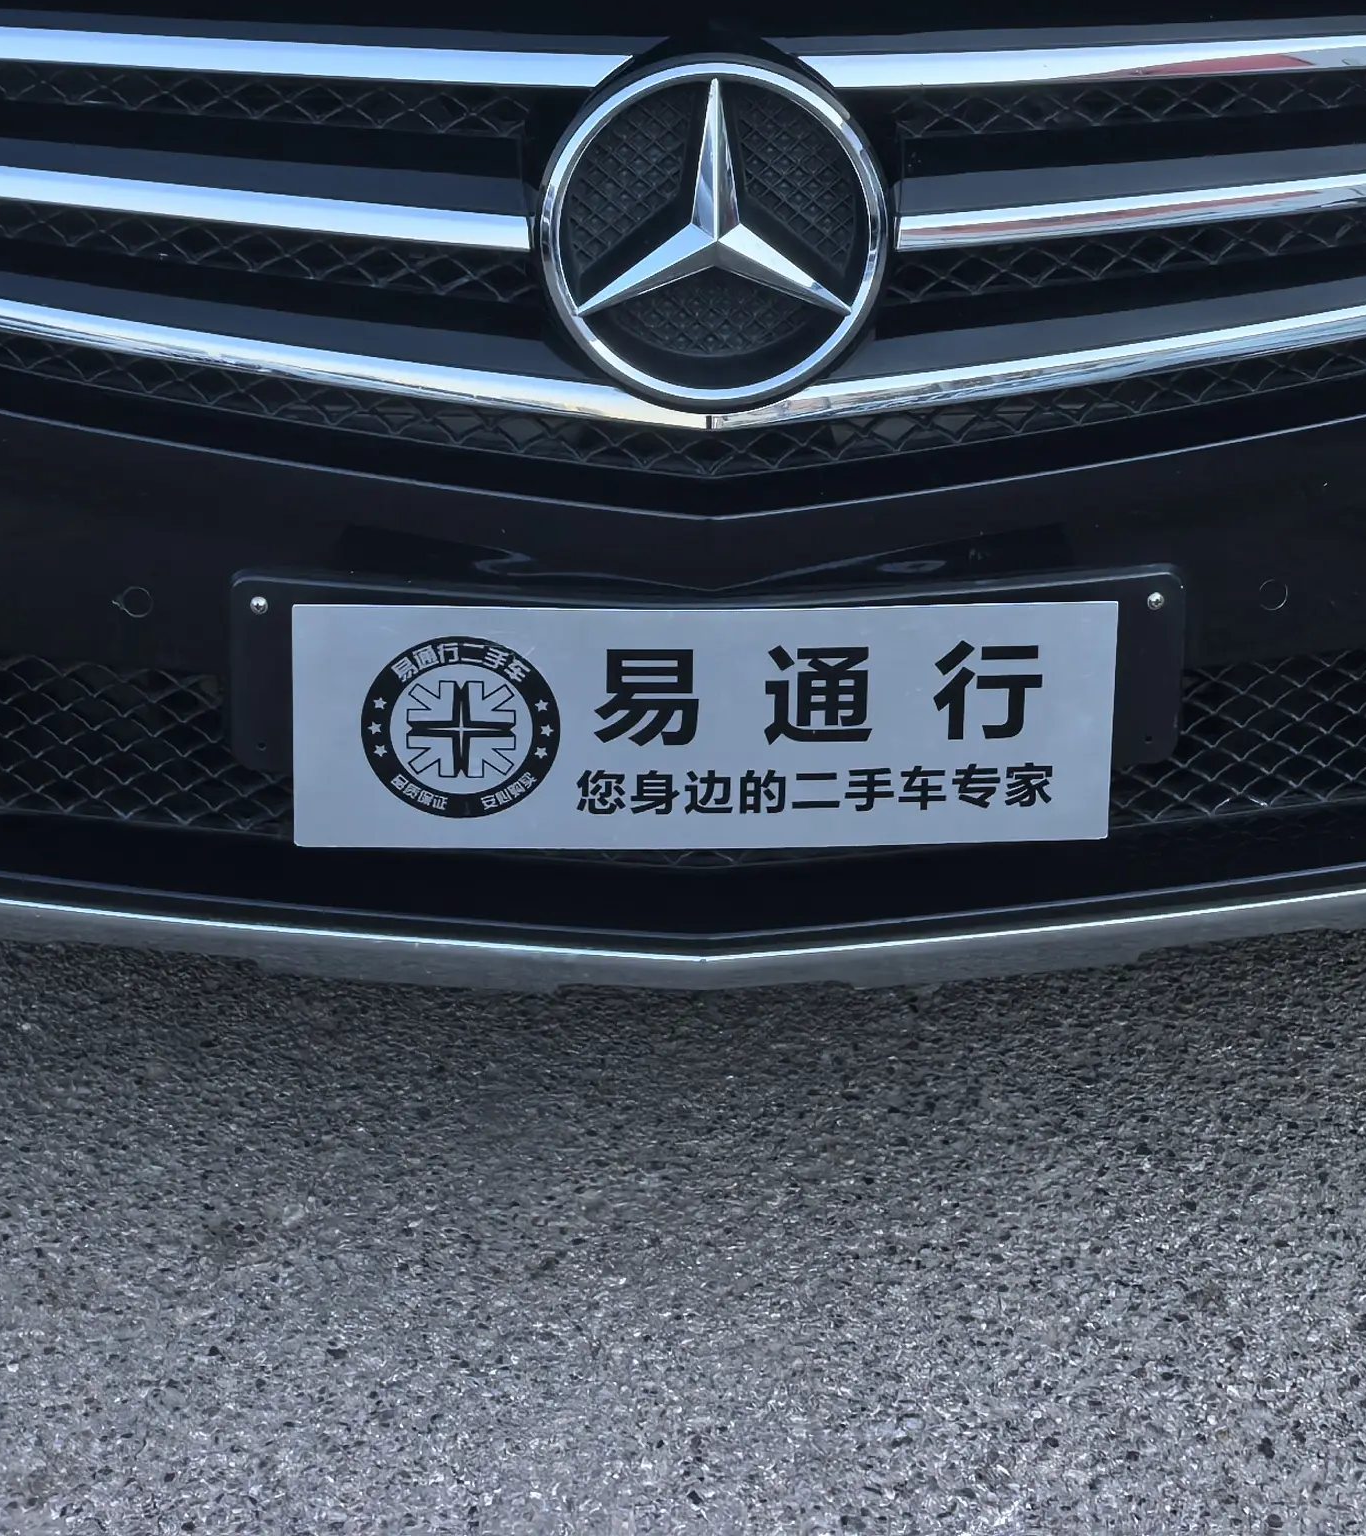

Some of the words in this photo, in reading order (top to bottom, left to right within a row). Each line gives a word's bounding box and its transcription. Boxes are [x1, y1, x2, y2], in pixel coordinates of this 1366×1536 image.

[390, 643, 531, 683] 易通行二手车
[594, 640, 1043, 747] 易通行
[390, 773, 449, 811] 品质保证
[480, 771, 538, 811] 安心购买
[576, 762, 1053, 815] 您身边的二手车专家
